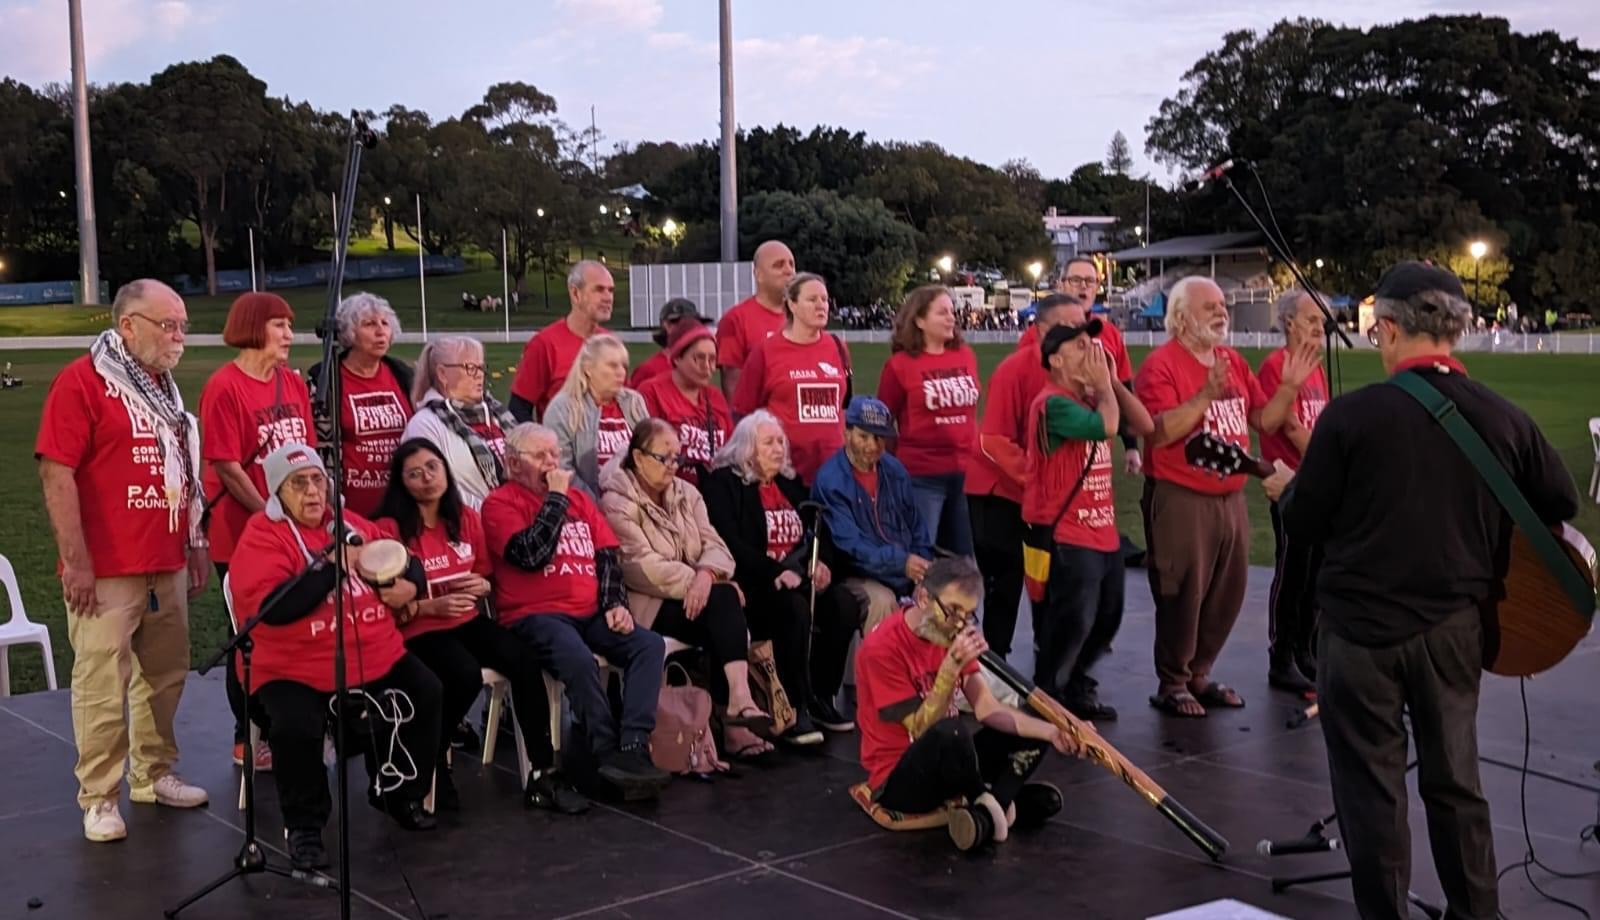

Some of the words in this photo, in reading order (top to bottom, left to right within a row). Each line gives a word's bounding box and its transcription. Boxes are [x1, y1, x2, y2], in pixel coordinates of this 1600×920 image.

[922, 375, 976, 395] STREET
[925, 387, 979, 411] CHOIR
[357, 403, 399, 418] STREET
[803, 404, 837, 418] CHOIR
[359, 414, 403, 431] CHOIR
[543, 562, 597, 578] PAYC
